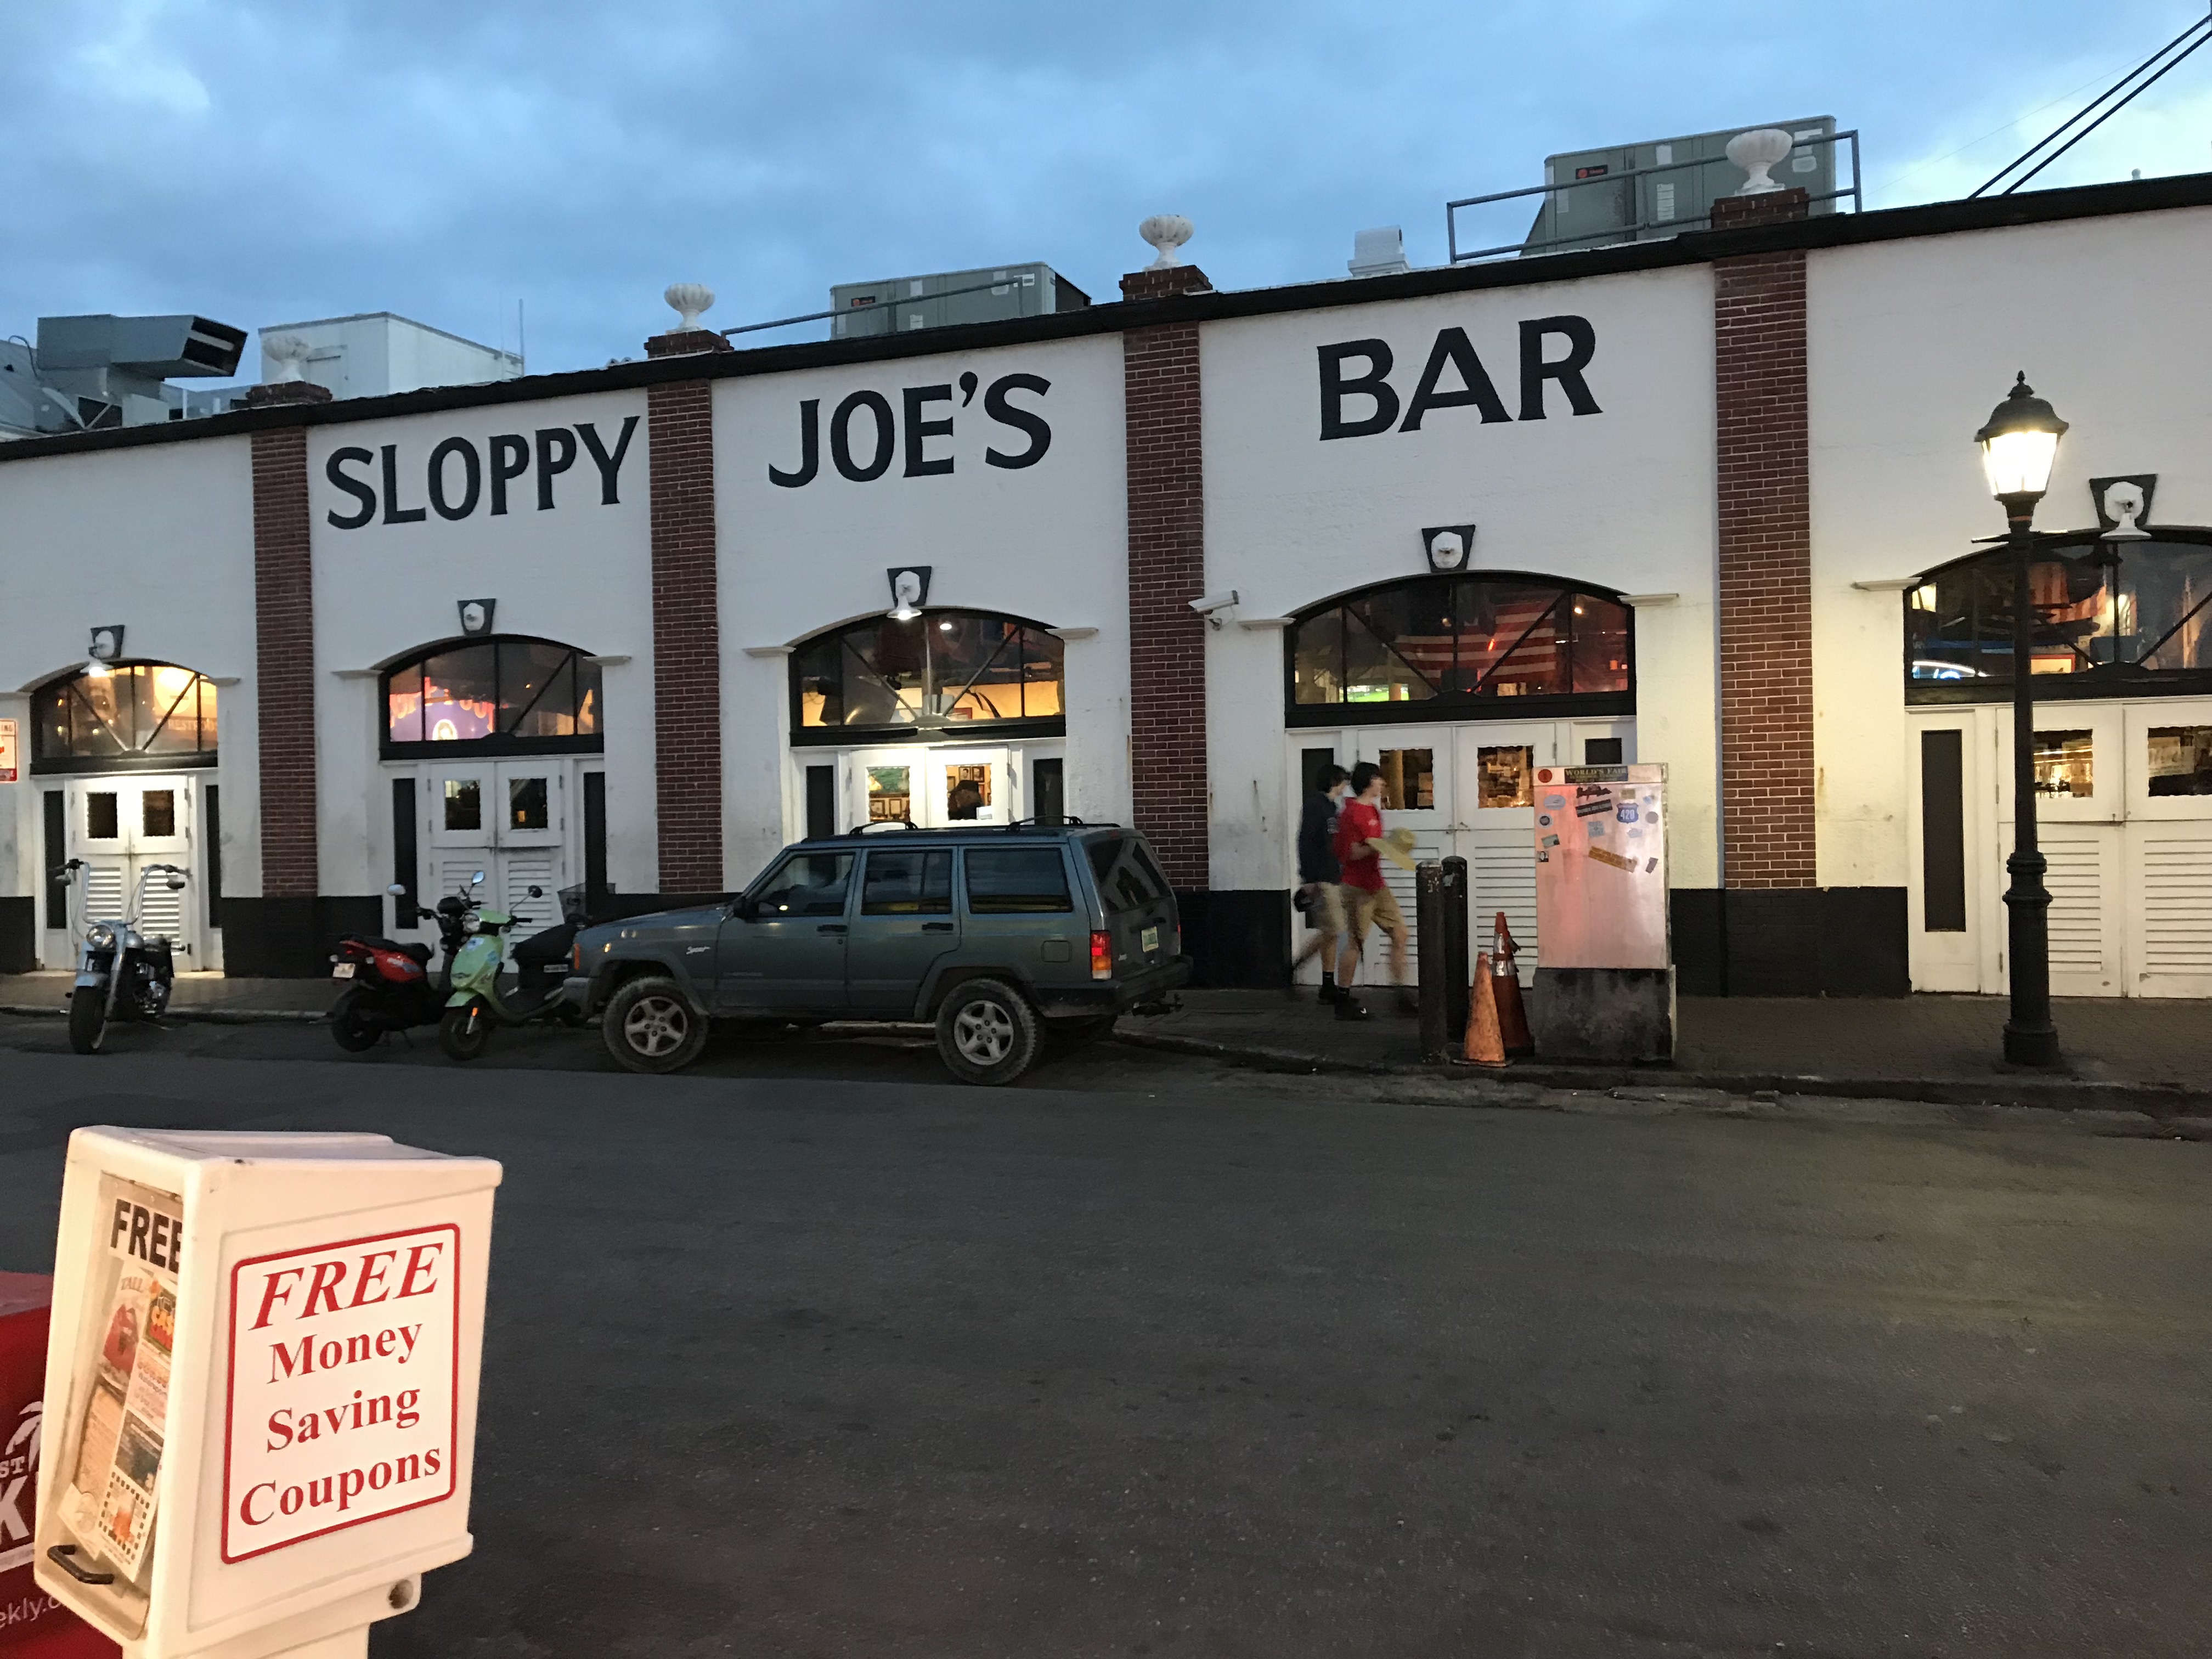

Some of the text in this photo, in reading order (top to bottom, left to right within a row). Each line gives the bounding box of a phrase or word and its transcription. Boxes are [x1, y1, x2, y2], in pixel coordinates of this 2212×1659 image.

[326, 315, 1604, 531] SLOPPY JOE'S BAR
[1620, 809, 1635, 820] 420
[110, 1198, 183, 1274] FREE
[248, 1242, 444, 1331] FREE
[267, 1323, 423, 1384] Money
[267, 1389, 421, 1454] Saving
[240, 1447, 441, 1526] Coupons
